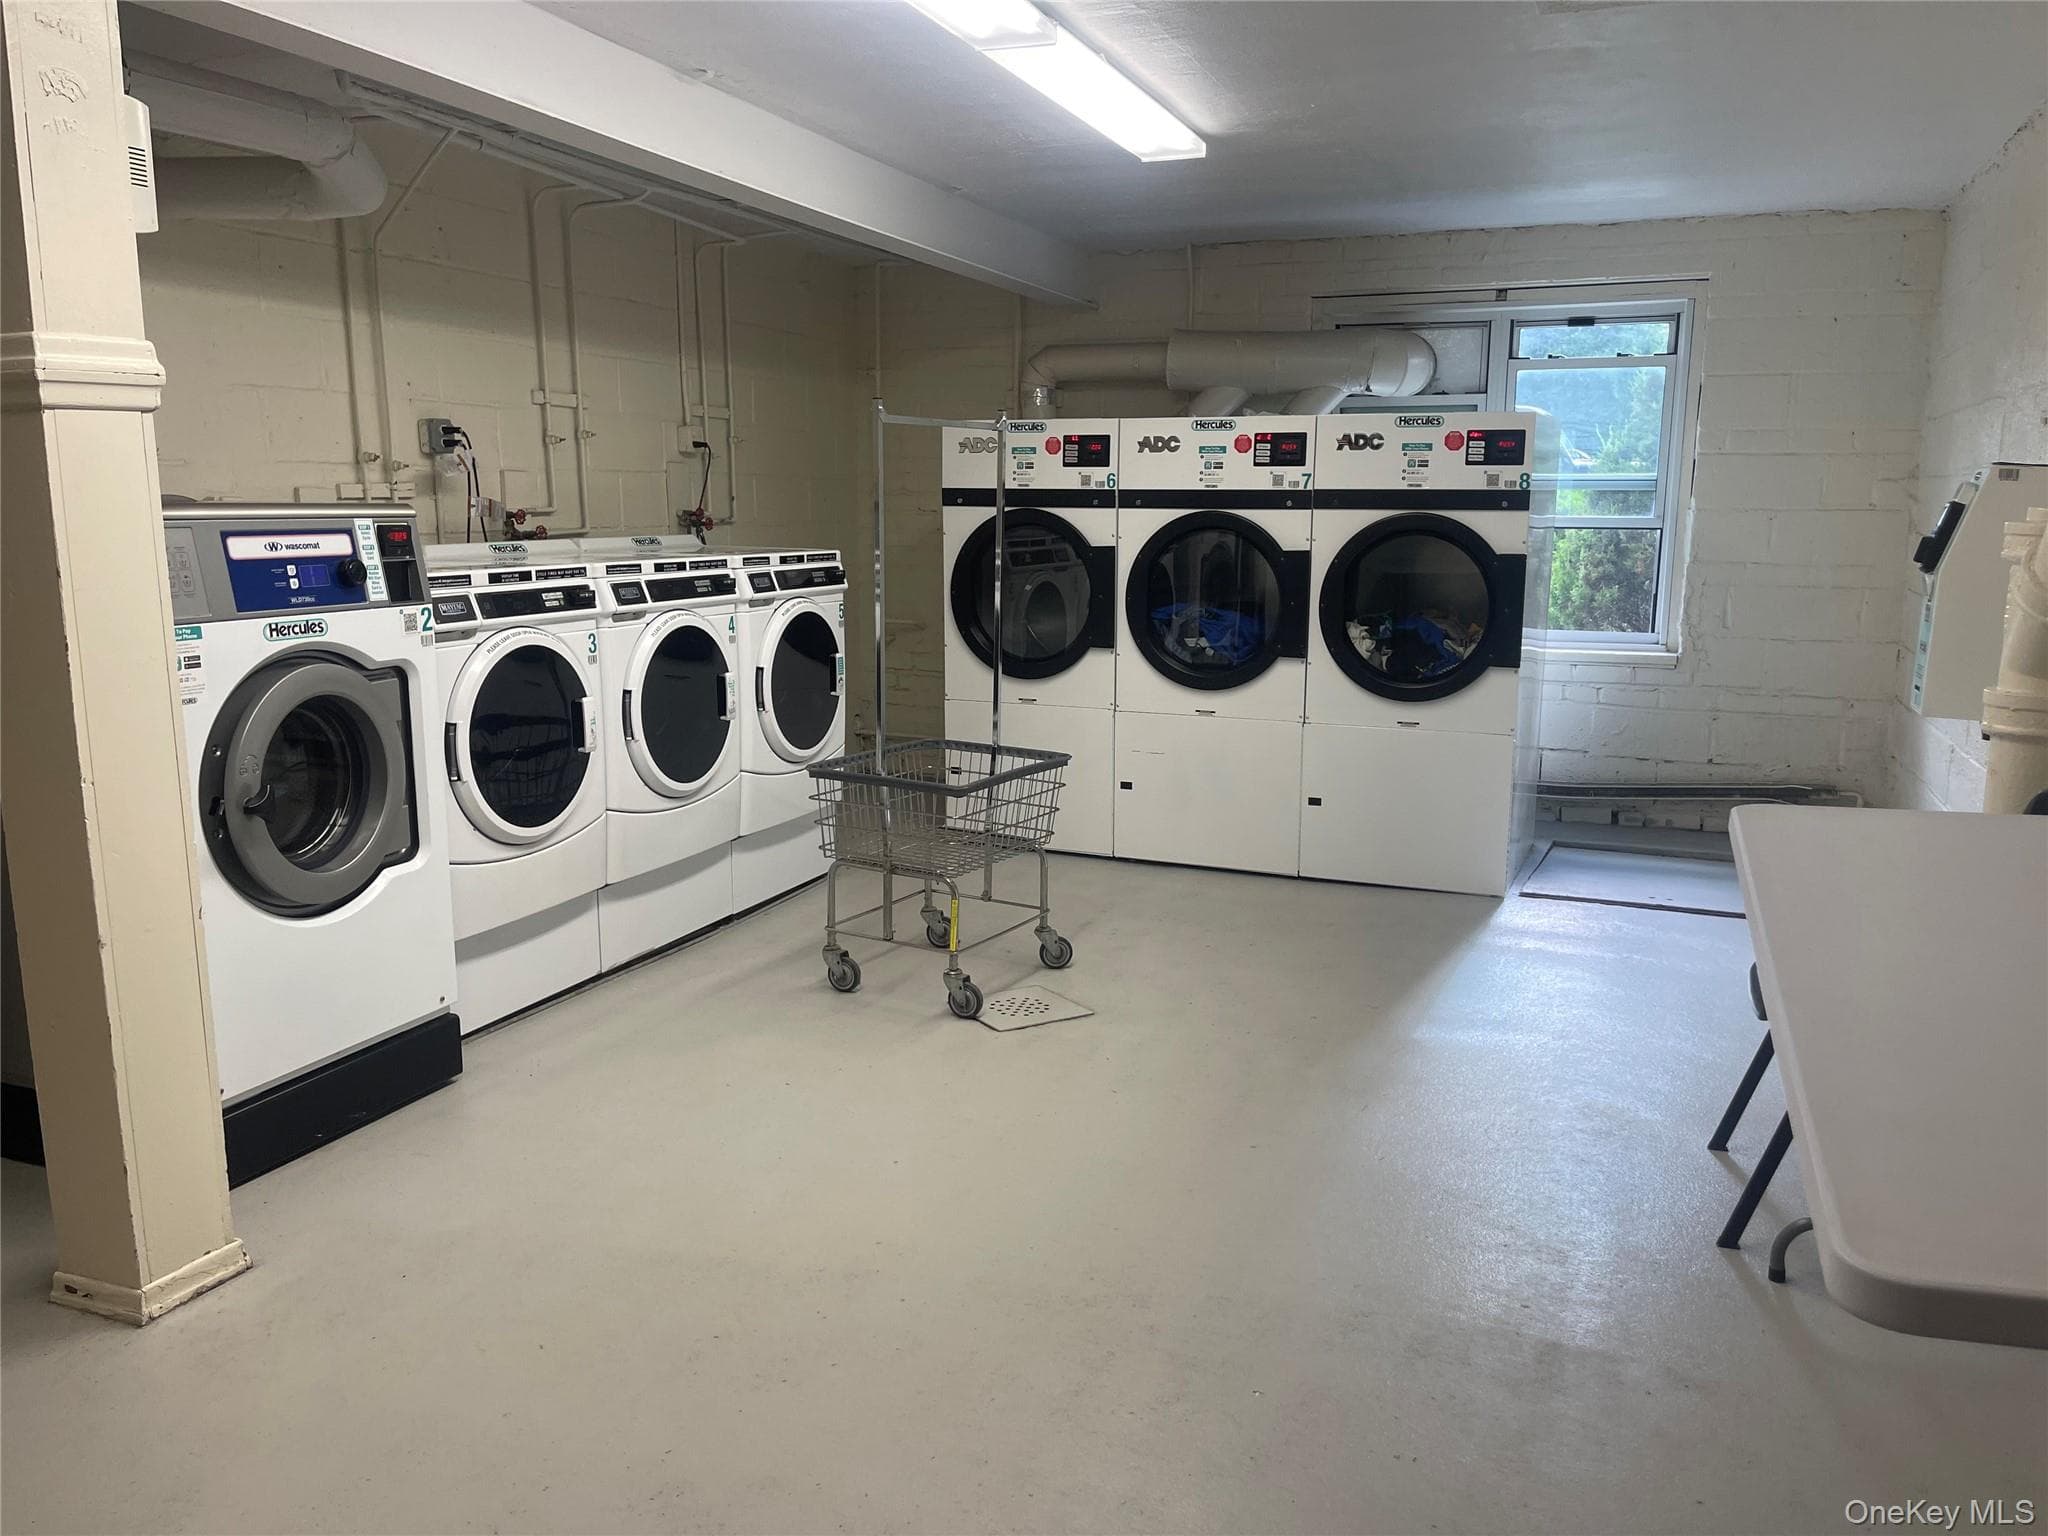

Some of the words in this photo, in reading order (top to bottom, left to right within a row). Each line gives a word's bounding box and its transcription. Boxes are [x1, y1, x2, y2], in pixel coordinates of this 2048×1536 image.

[1009, 422, 1044, 431] Hercules
[1195, 420, 1233, 429] Hercules
[1399, 416, 1441, 426] Hercules
[958, 436, 998, 454] ADC
[1137, 435, 1181, 453] ADC
[1335, 432, 1385, 451] ADC
[1106, 472, 1116, 489] 6
[1301, 473, 1312, 489] 7
[1518, 472, 1531, 490] 8
[284, 541, 321, 550] wascomat
[490, 544, 527, 553] Hercules
[420, 607, 433, 632] 2
[838, 603, 844, 619] 5
[268, 620, 324, 638] Hercules
[728, 615, 735, 634] 4
[588, 633, 597, 654] 3
